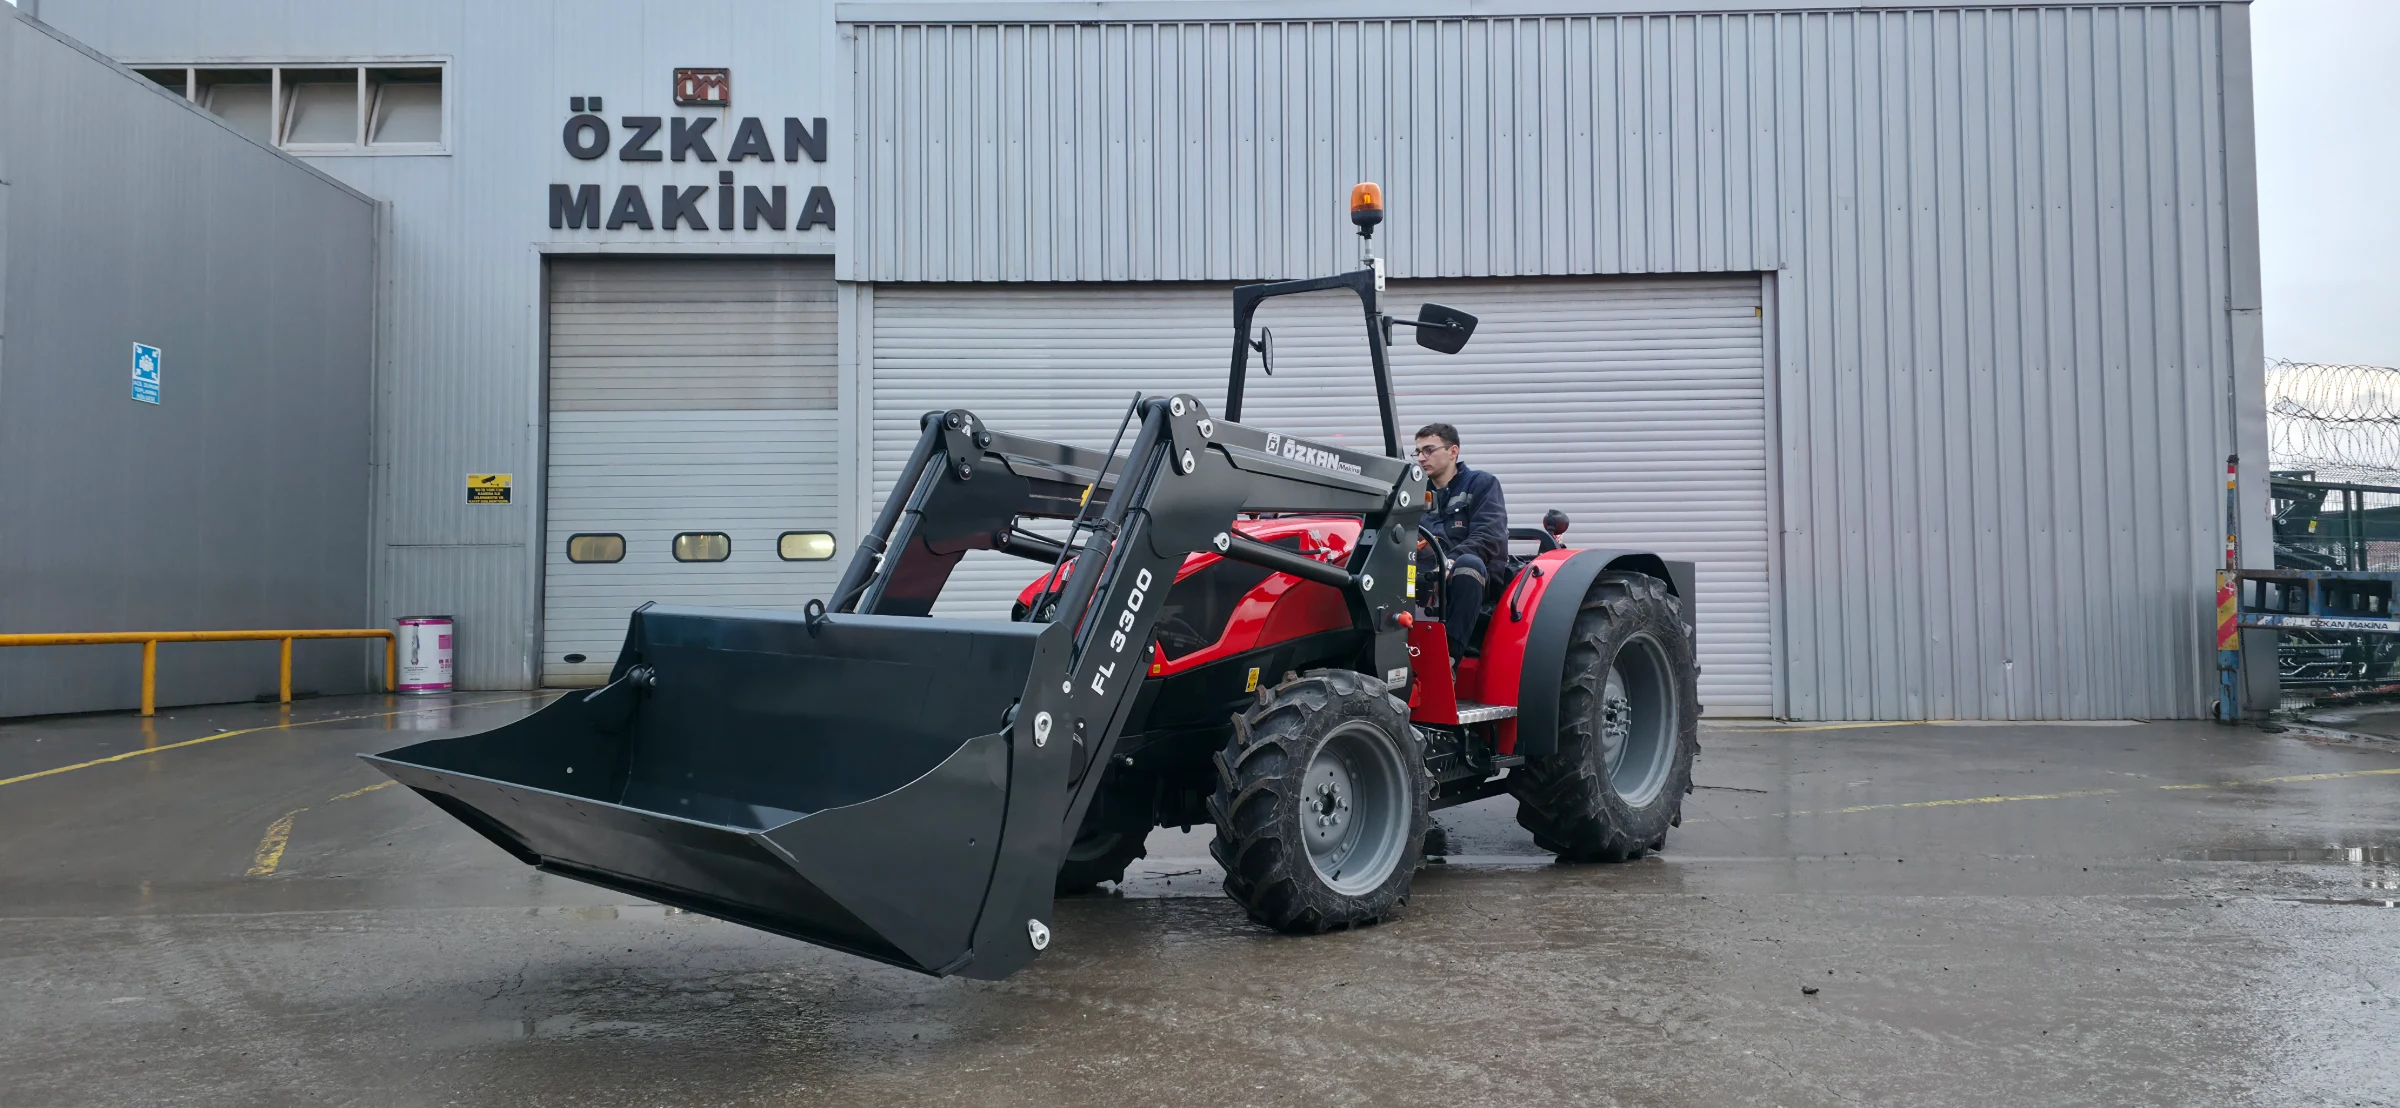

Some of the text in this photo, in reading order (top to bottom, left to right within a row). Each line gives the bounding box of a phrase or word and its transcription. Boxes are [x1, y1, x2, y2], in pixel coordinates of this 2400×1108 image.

[563, 96, 827, 162] ÖZKAN
[549, 170, 836, 230] MAKİNA
[1283, 439, 1339, 470] ÖZKAN
[1091, 568, 1152, 696] FL 3300
